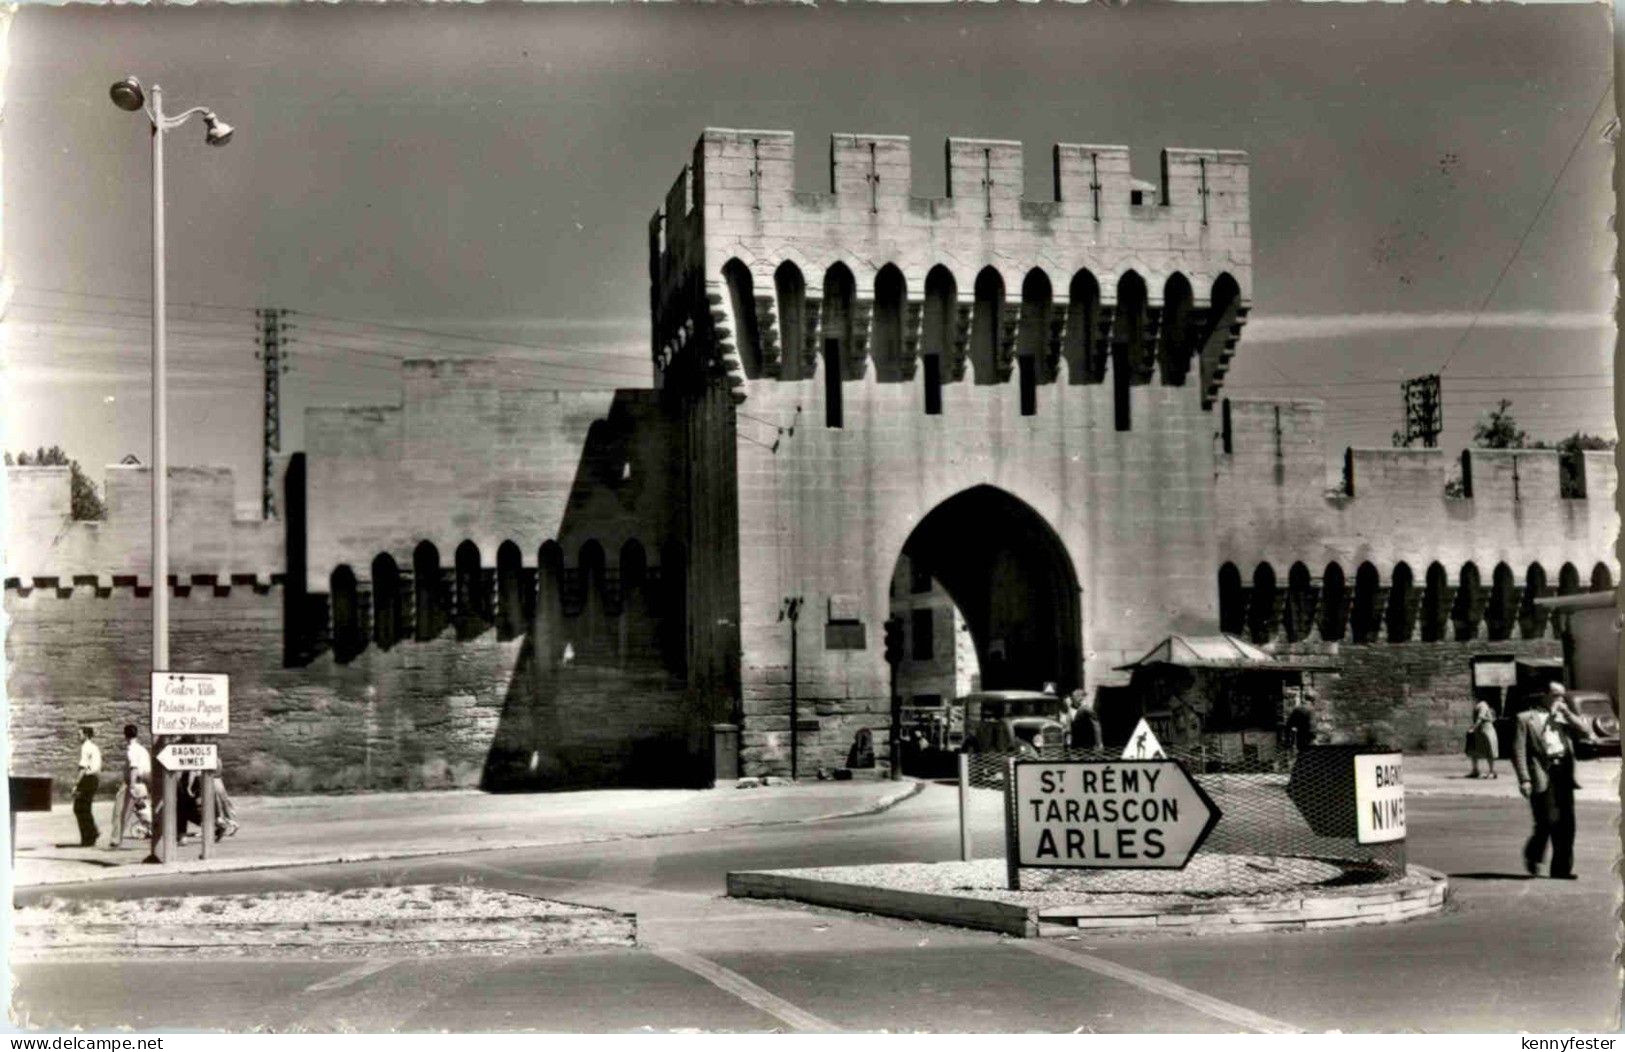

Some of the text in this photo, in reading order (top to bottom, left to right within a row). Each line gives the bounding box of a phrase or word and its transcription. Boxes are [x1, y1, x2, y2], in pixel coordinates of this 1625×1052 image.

[171, 747, 211, 756] BAGNOLS
[178, 757, 205, 766] NIMES
[1083, 766, 1161, 793] RÉMY
[1030, 799, 1178, 823] TARASCON
[1036, 829, 1166, 859] ARLES
